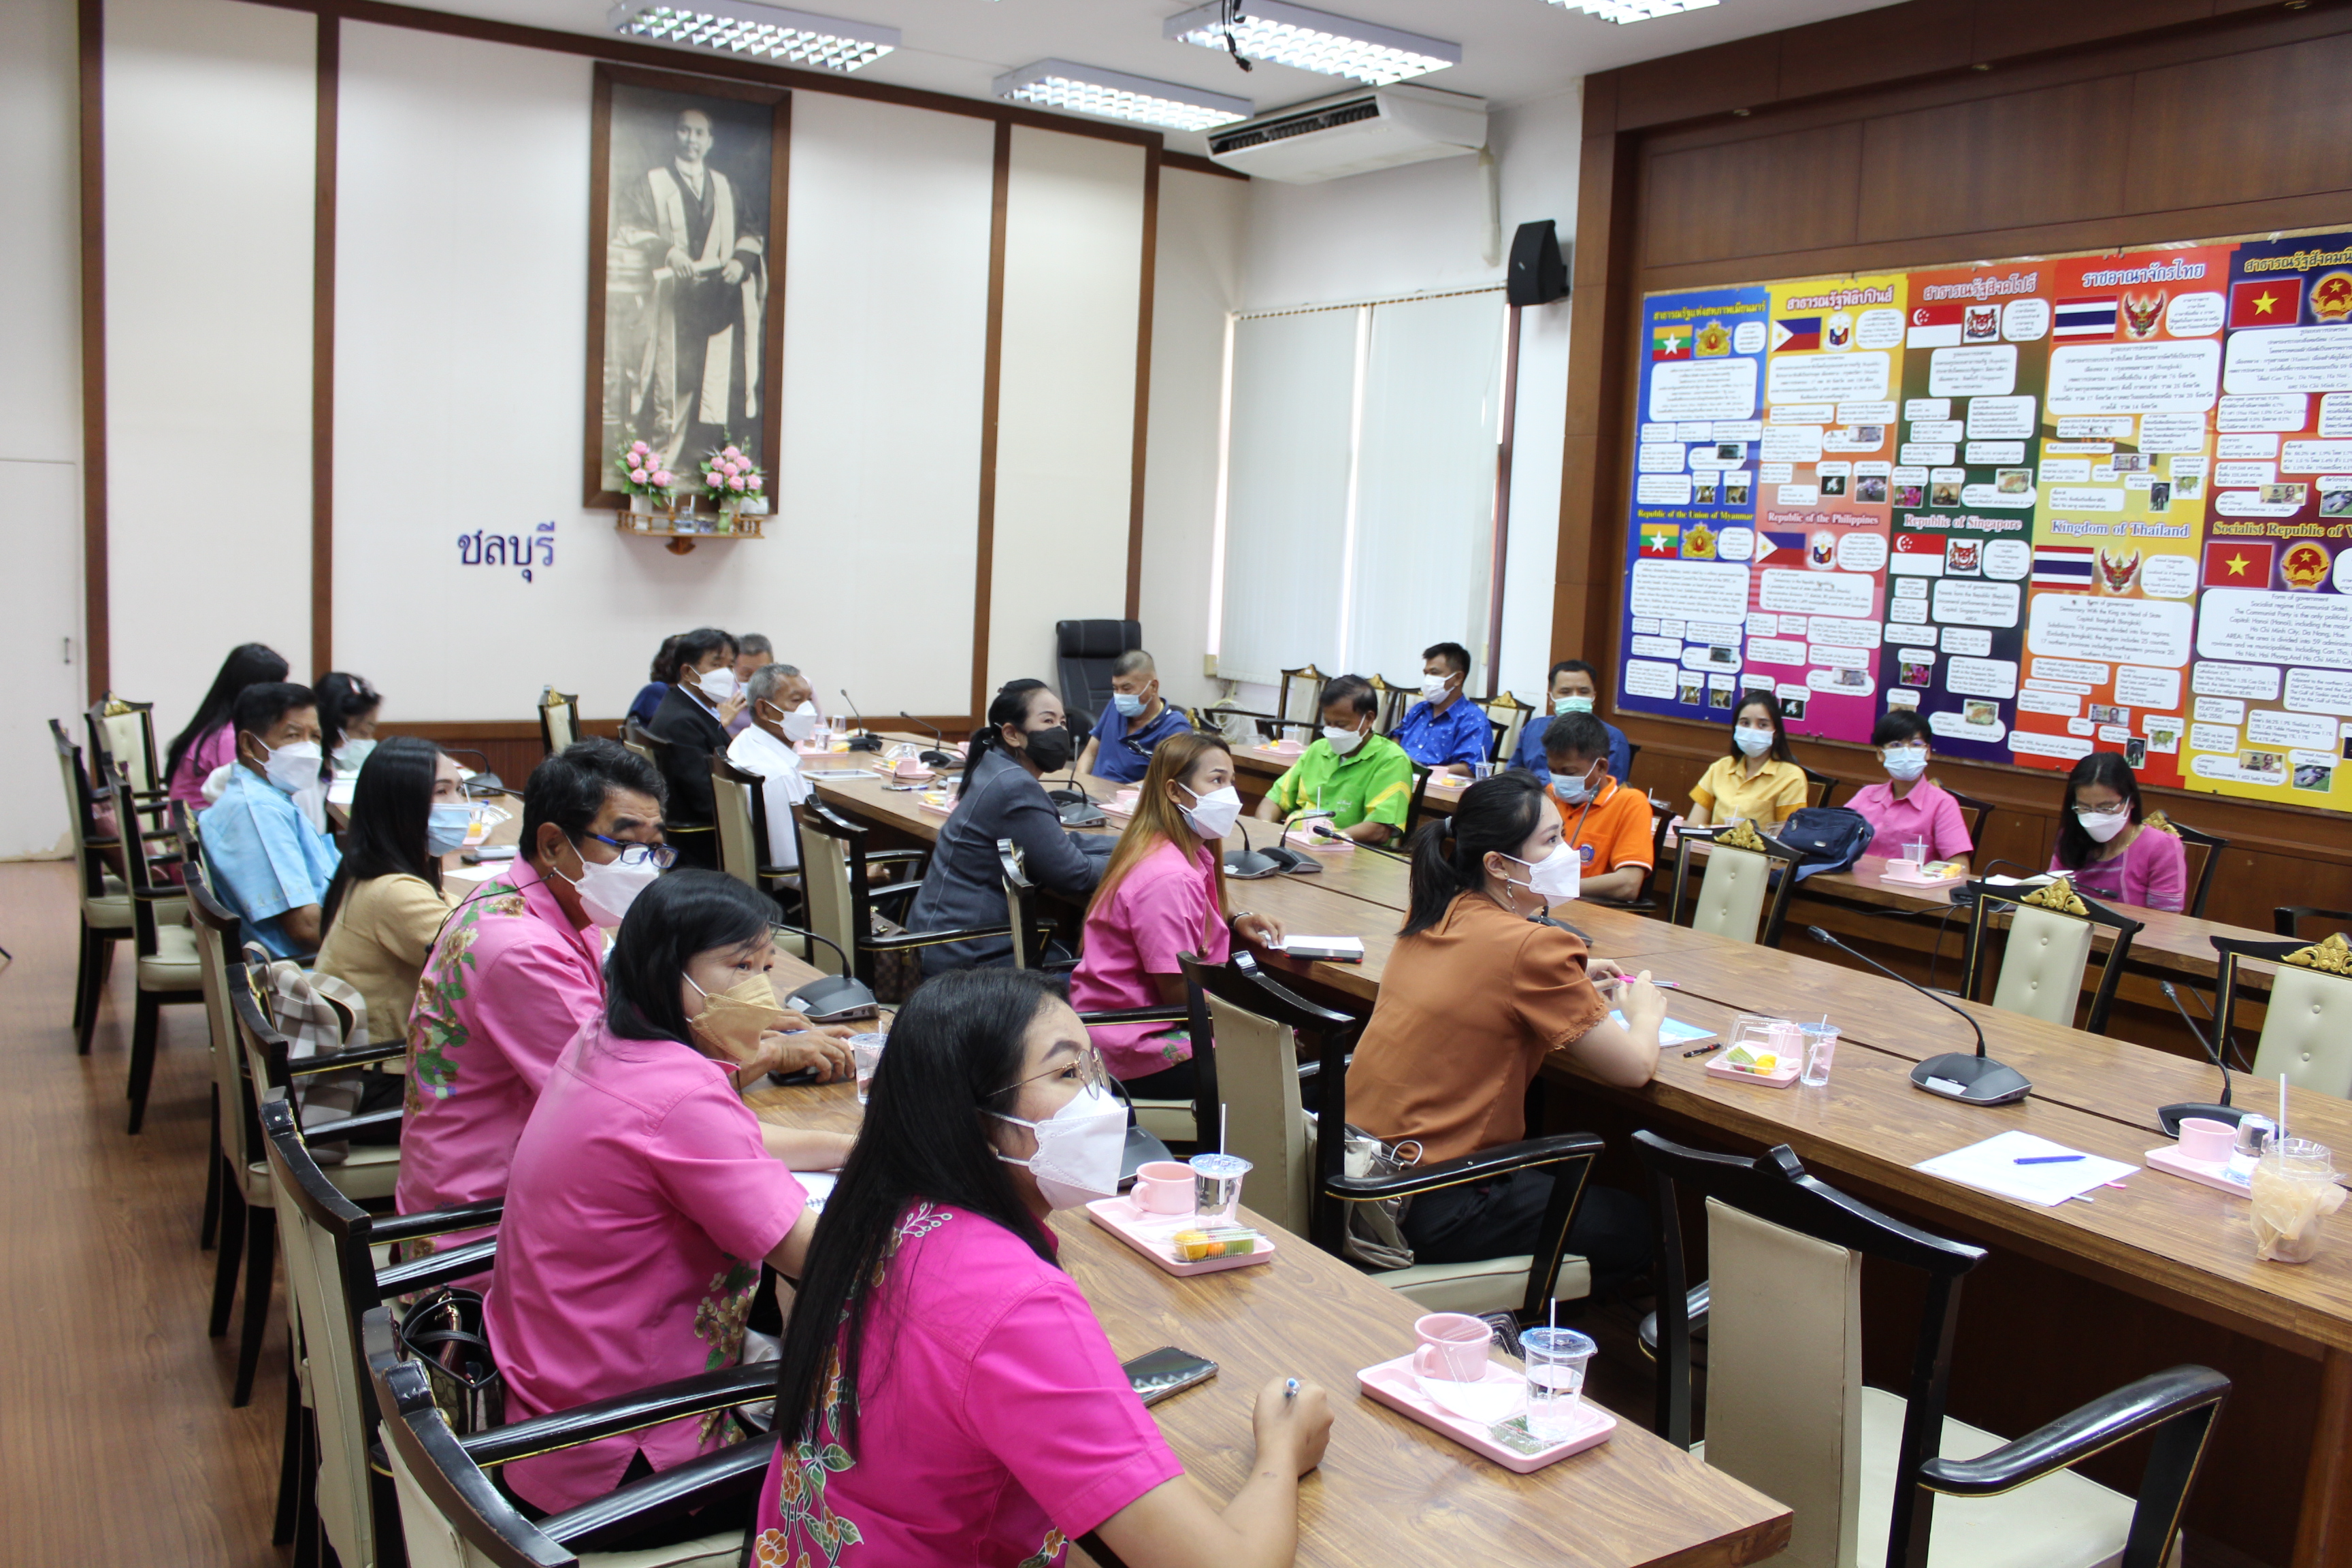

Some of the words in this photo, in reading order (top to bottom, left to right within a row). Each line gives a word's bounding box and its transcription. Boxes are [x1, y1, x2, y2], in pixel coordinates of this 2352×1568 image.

[2081, 259, 2206, 287] ราชอาณาจักรไทย
[1923, 272, 2038, 301] สาธารณรัฐสิงคโปร์
[1786, 284, 1895, 311] สาธารณรัฐฟิลิปปินส์
[1637, 509, 1665, 519] Republic
[1688, 510, 1709, 519] Union
[1720, 512, 1754, 521] Myanmar
[1767, 511, 1803, 524] Republic
[1805, 512, 1814, 523] of
[1816, 513, 1829, 523] the
[1831, 513, 1879, 527] Philippines
[1904, 513, 1951, 529] Republic
[1952, 514, 1965, 528] of
[1966, 516, 2023, 532] Singapore
[2051, 519, 2109, 537] Kingdom
[2111, 521, 2127, 536] of
[2129, 522, 2191, 539] Thailand
[2212, 521, 2265, 536] Socialist
[2266, 523, 2325, 538] Republic
[2326, 524, 2342, 538] of
[457, 521, 555, 583] ชลบุรี
